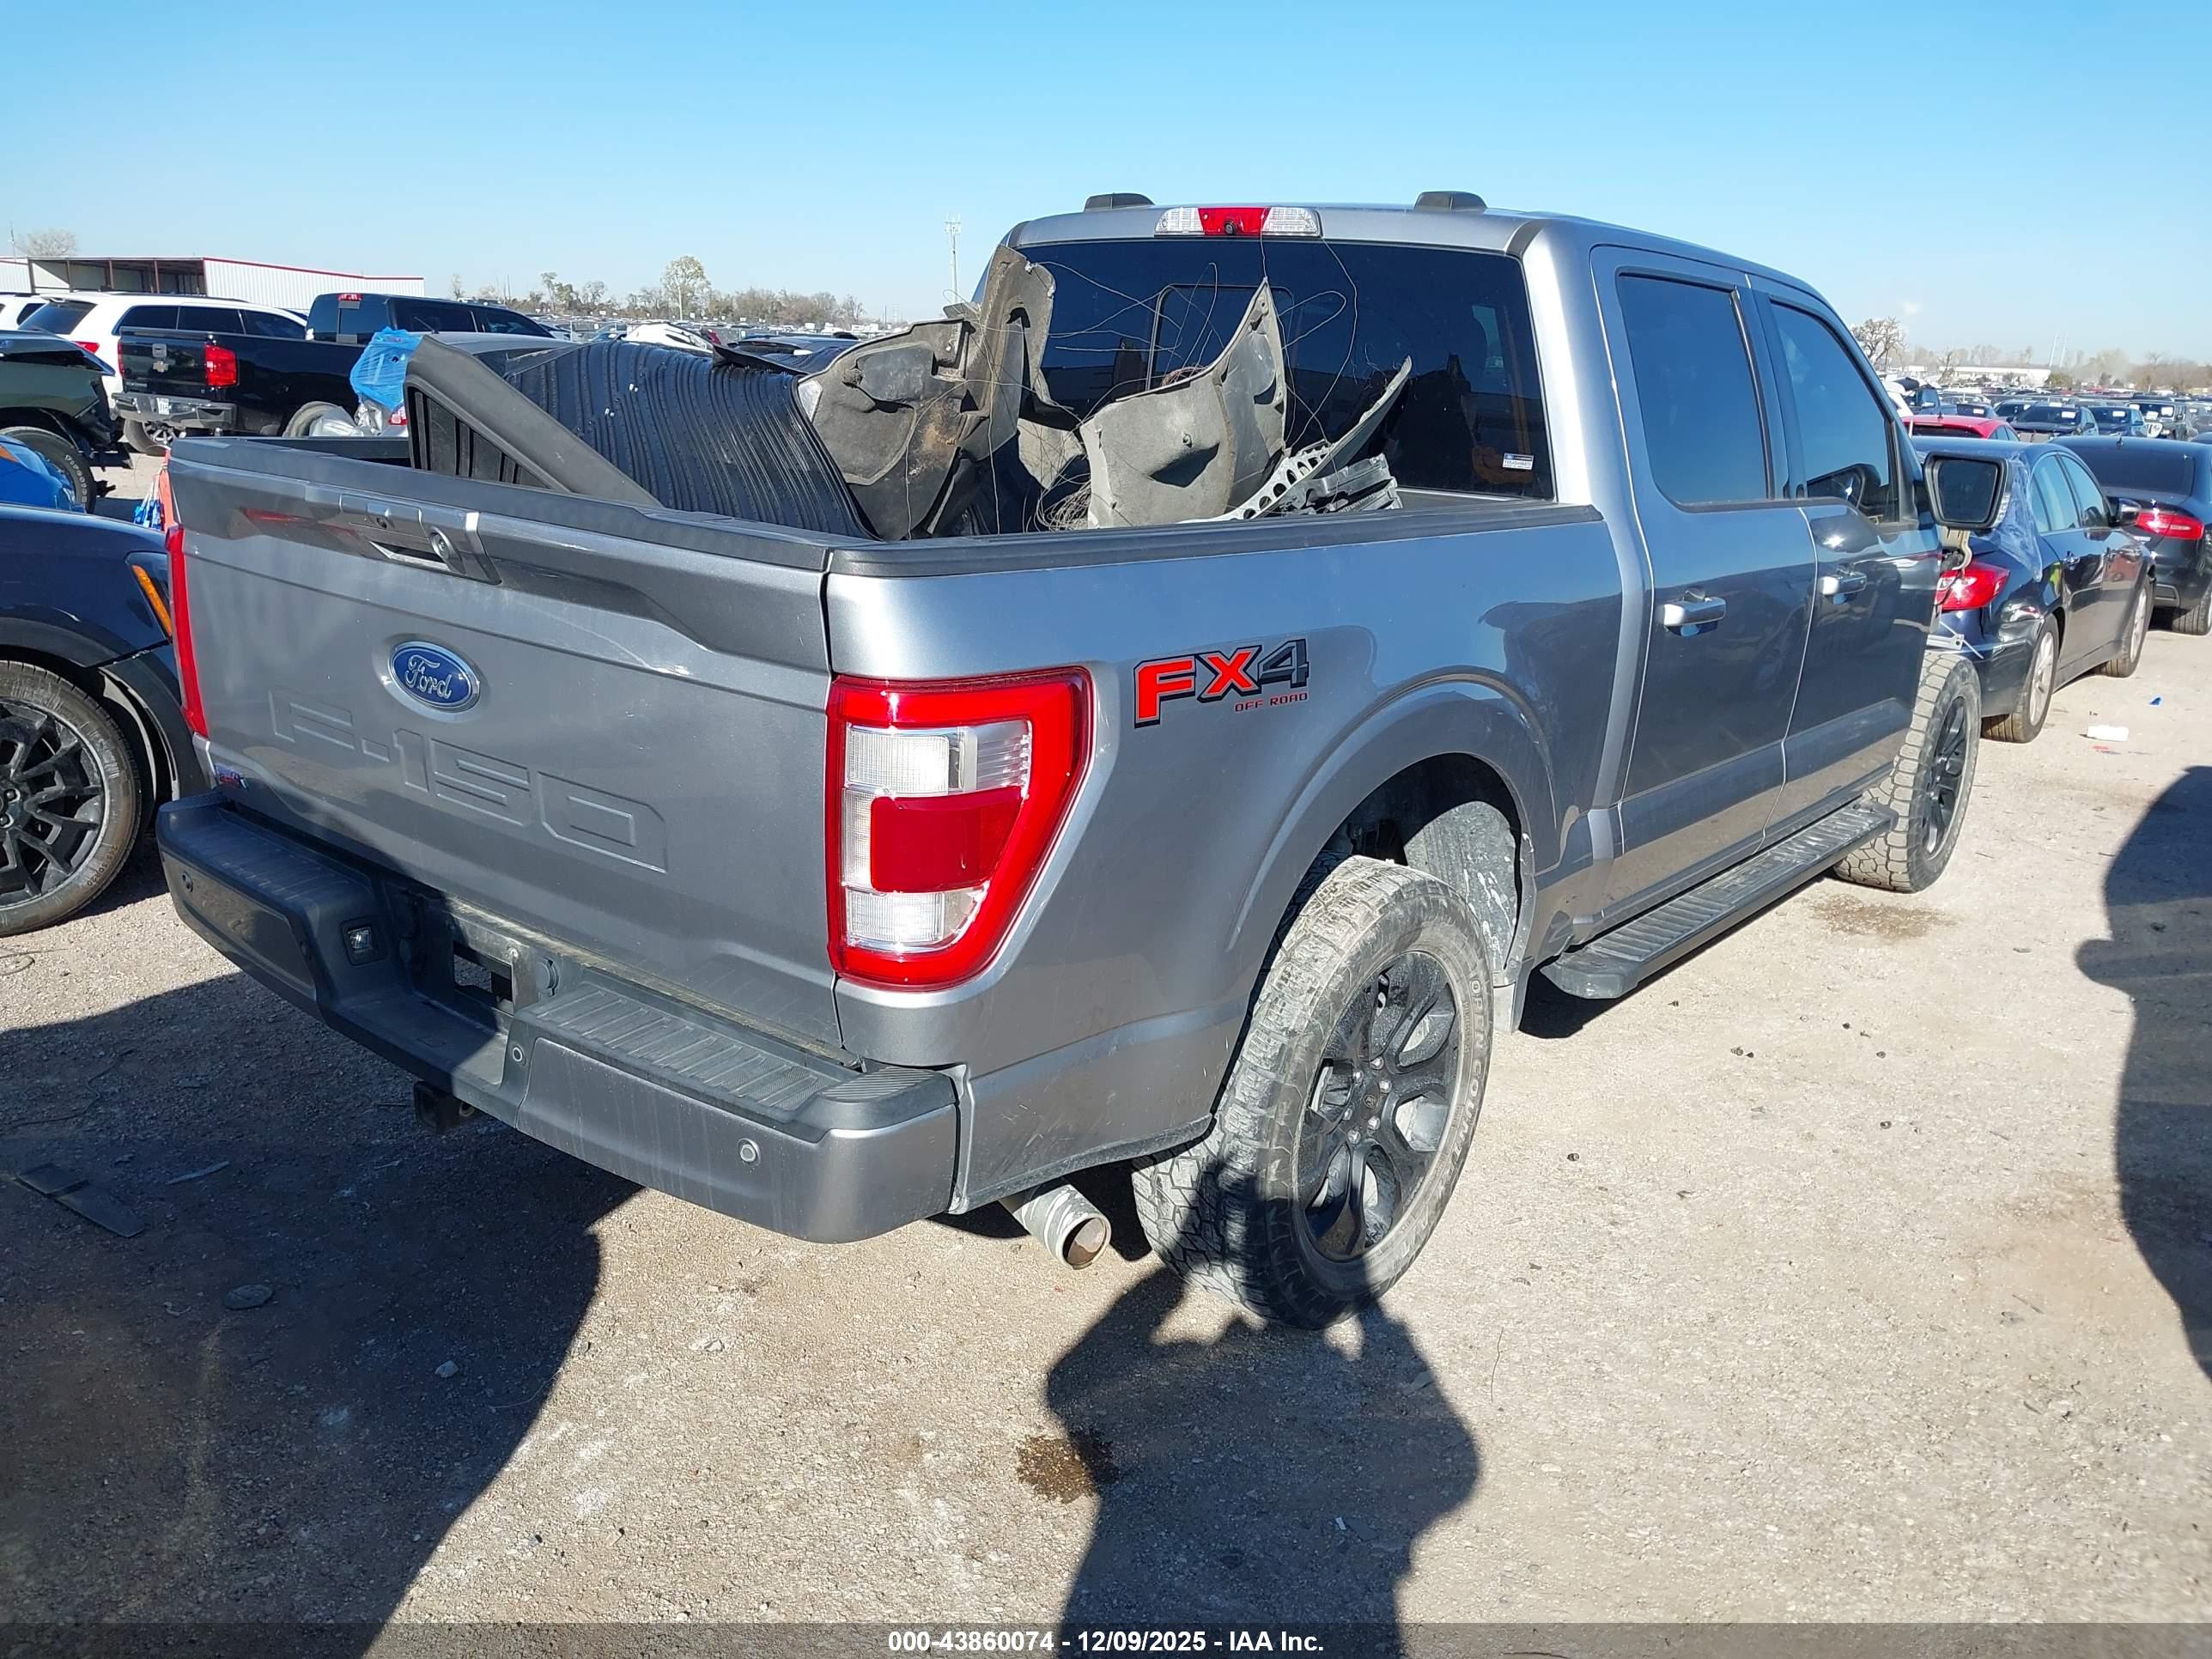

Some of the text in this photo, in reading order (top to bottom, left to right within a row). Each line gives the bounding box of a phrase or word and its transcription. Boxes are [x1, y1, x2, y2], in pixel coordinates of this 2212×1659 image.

[404, 654, 453, 699] Ford
[1133, 638, 1310, 729] FX4
[1235, 692, 1308, 713] OFF ROAD
[268, 689, 668, 874] F-150
[1470, 979, 1486, 1049] OPEN
